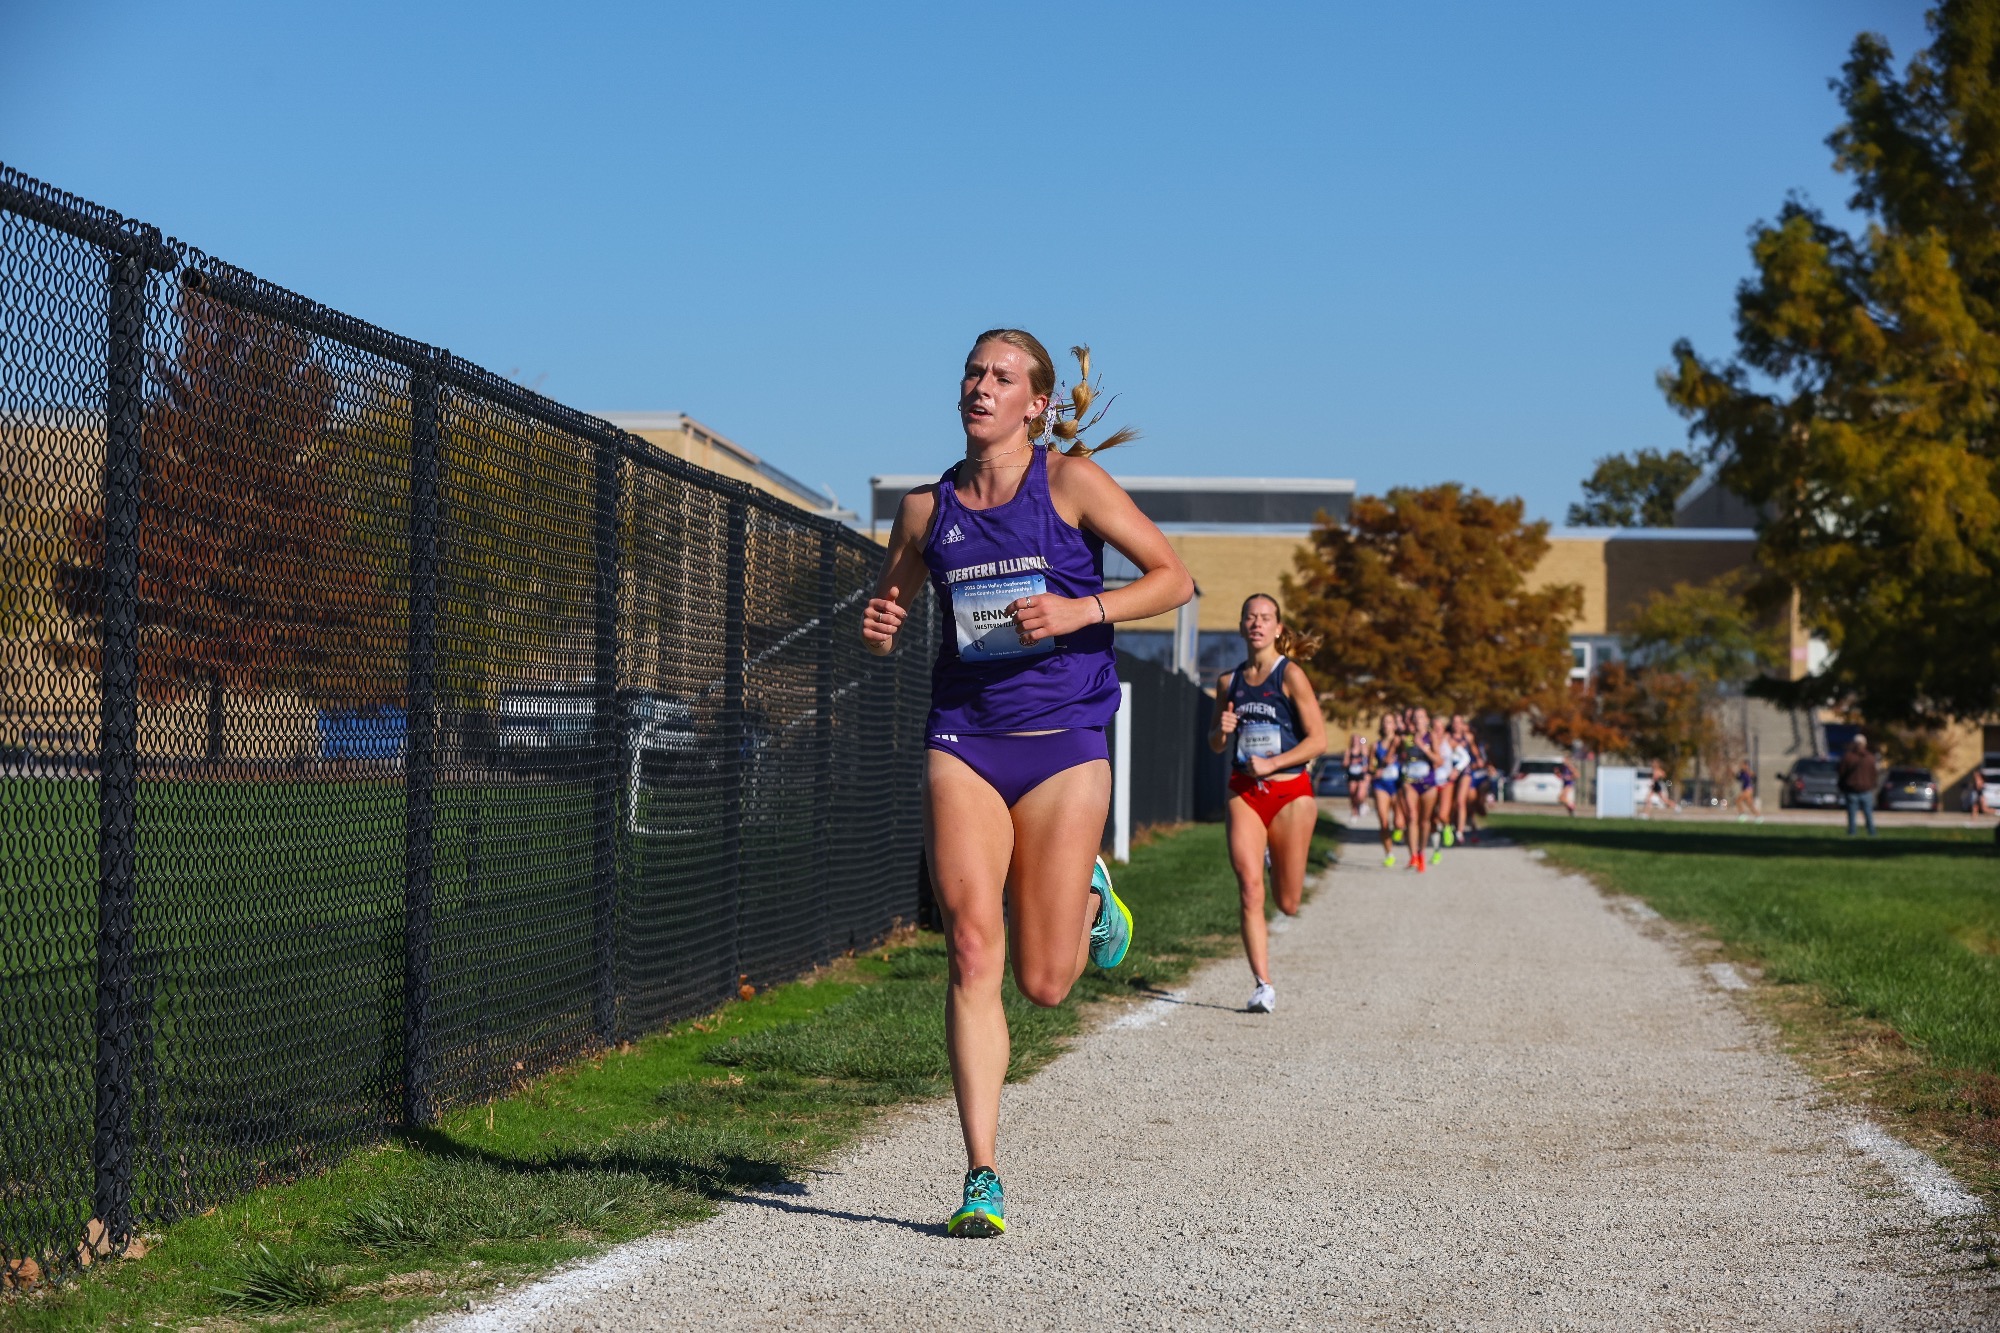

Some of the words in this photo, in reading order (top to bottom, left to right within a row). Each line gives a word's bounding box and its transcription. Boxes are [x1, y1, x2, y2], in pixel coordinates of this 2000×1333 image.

[942, 534, 965, 545] adidas
[946, 562, 997, 584] WESTERN
[996, 586, 1033, 594] Championships
[972, 609, 1012, 622] BENN
